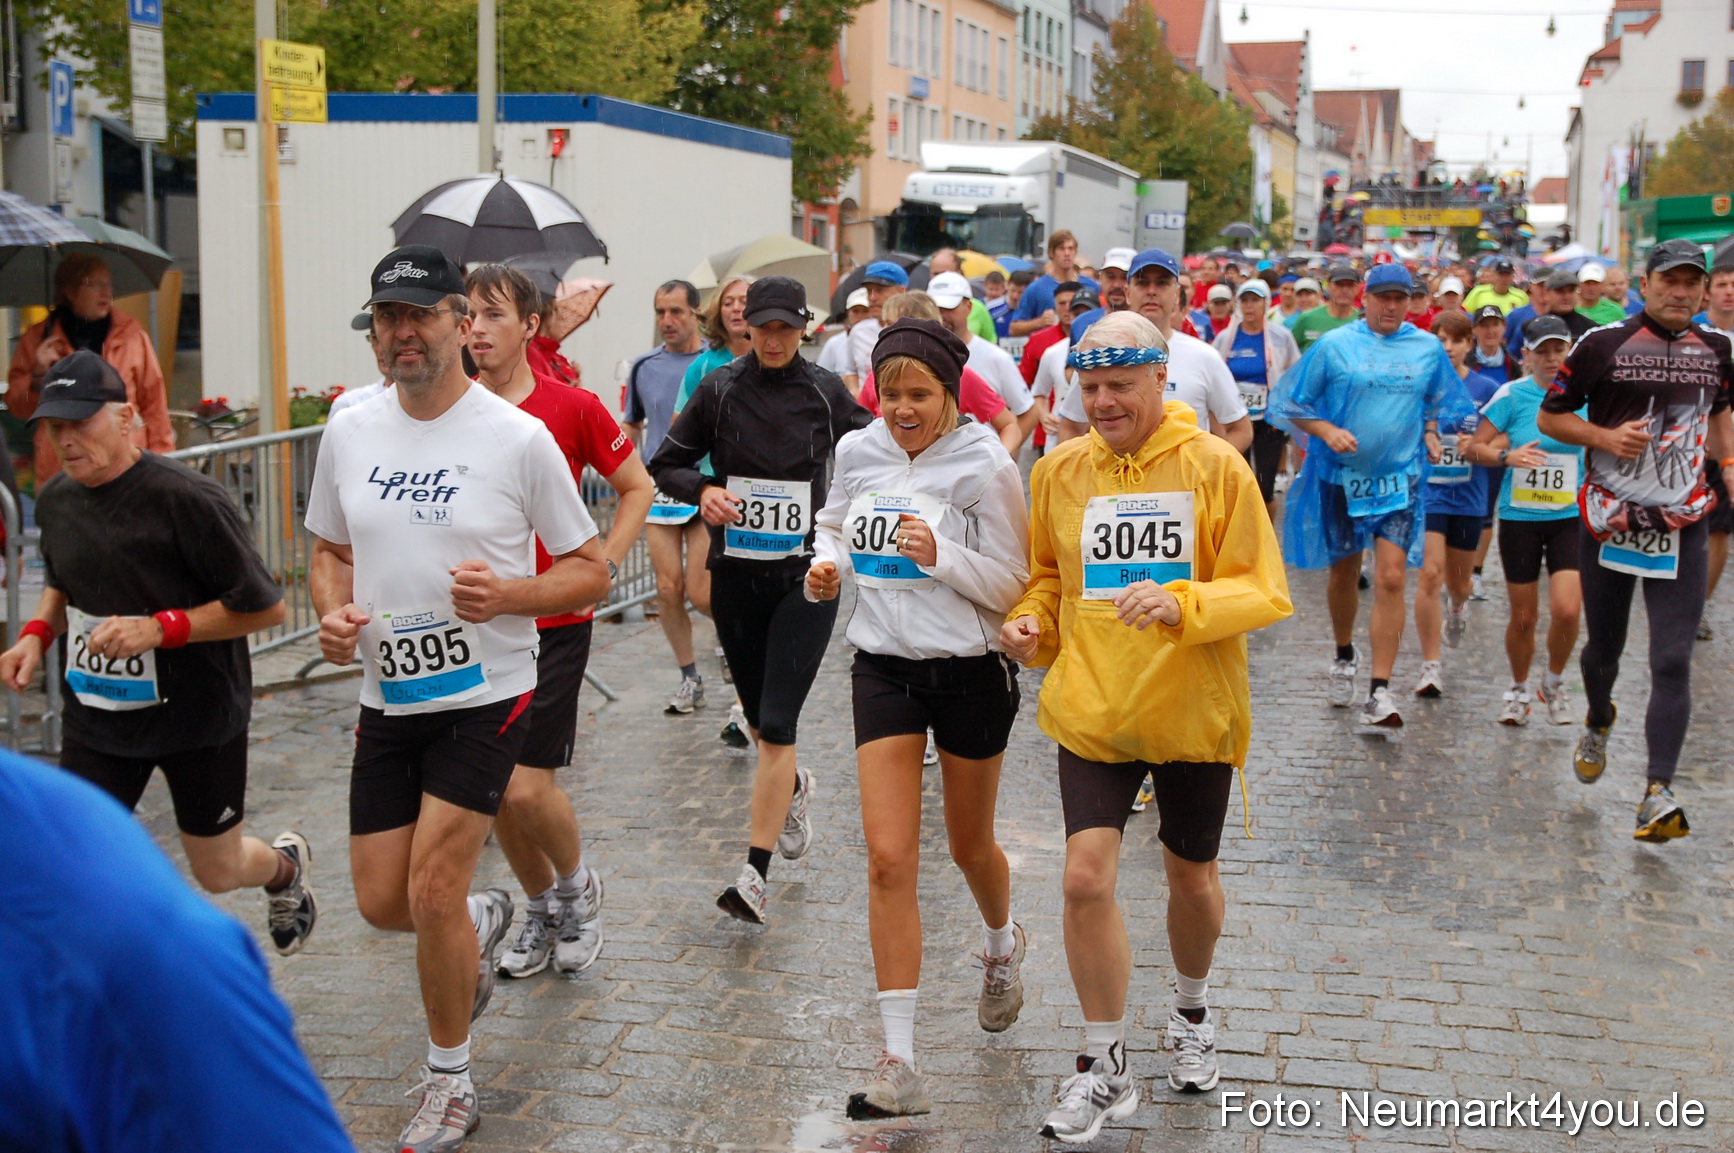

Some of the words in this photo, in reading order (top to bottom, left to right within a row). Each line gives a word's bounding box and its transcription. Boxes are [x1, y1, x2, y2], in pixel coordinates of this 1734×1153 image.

[368, 466, 450, 486] Lauf
[1525, 469, 1564, 489] 418
[379, 481, 460, 503] Treff
[1350, 477, 1399, 499] 2201
[732, 499, 801, 531] 3318
[737, 534, 791, 549] Katharina
[1092, 521, 1182, 560] 3045
[874, 560, 899, 575] Jina
[392, 612, 435, 627] BOCK
[379, 626, 471, 678] 3395
